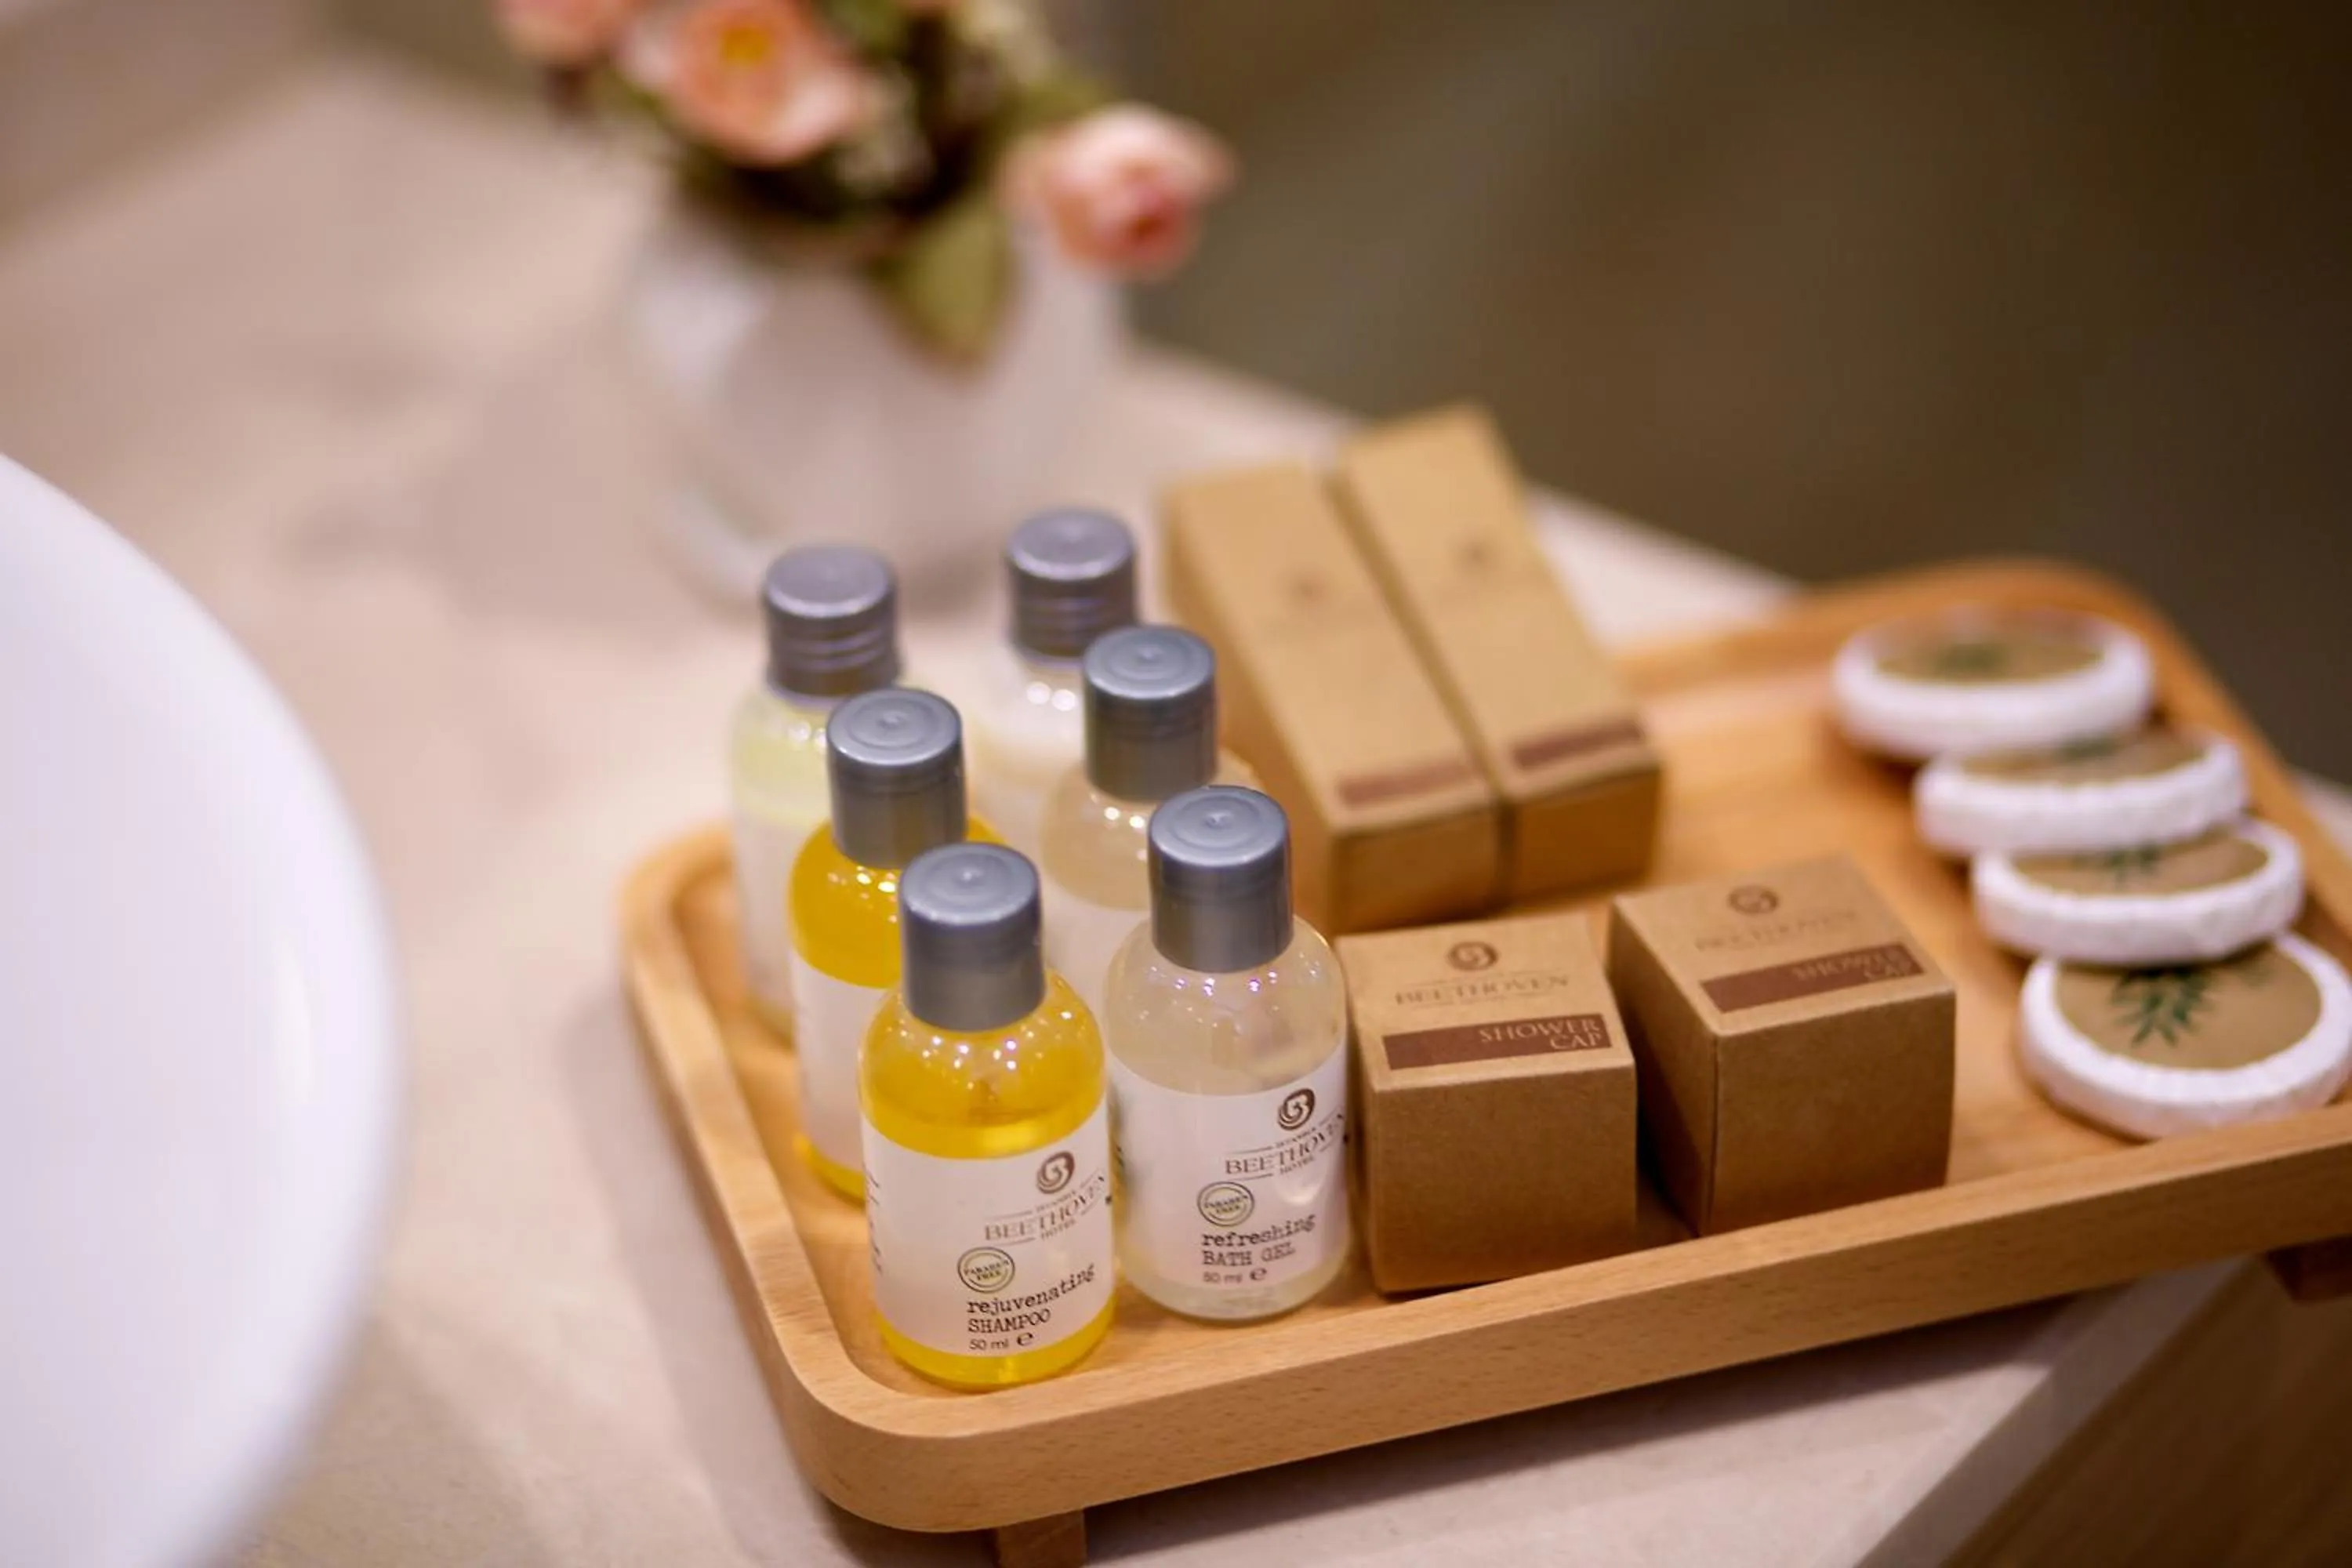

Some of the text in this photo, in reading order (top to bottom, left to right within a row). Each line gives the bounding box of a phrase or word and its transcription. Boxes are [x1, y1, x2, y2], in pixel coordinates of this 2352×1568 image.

[1395, 975, 1569, 1005] BEETHOVEN
[1479, 1018, 1601, 1044] SHOWER
[1549, 1033, 1602, 1051] CAP
[1202, 1214, 1316, 1247] refreshing
[1202, 1241, 1296, 1267] BATH GEL
[967, 1262, 1094, 1316] rejuvenating
[968, 1308, 1051, 1334] SHAMPOO
[969, 1338, 987, 1351] 50
[990, 1338, 1009, 1350] ml
